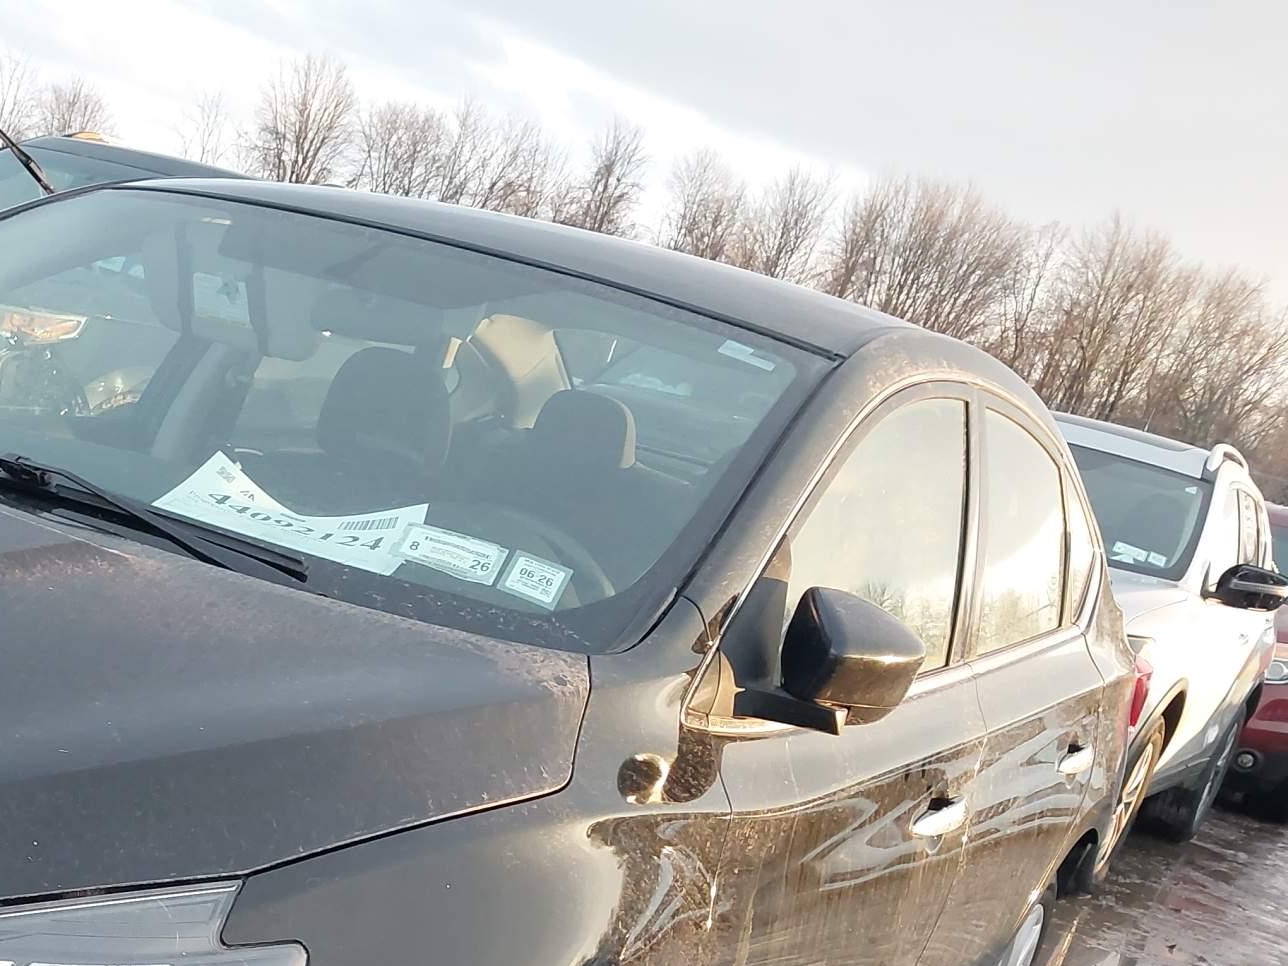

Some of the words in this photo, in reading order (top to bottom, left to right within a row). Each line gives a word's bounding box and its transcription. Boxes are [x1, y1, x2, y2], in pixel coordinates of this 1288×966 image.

[208, 492, 385, 551] 44092124
[409, 541, 420, 551] 8
[469, 559, 491, 572] 26
[519, 567, 536, 579] 06
[537, 574, 554, 587] 26
